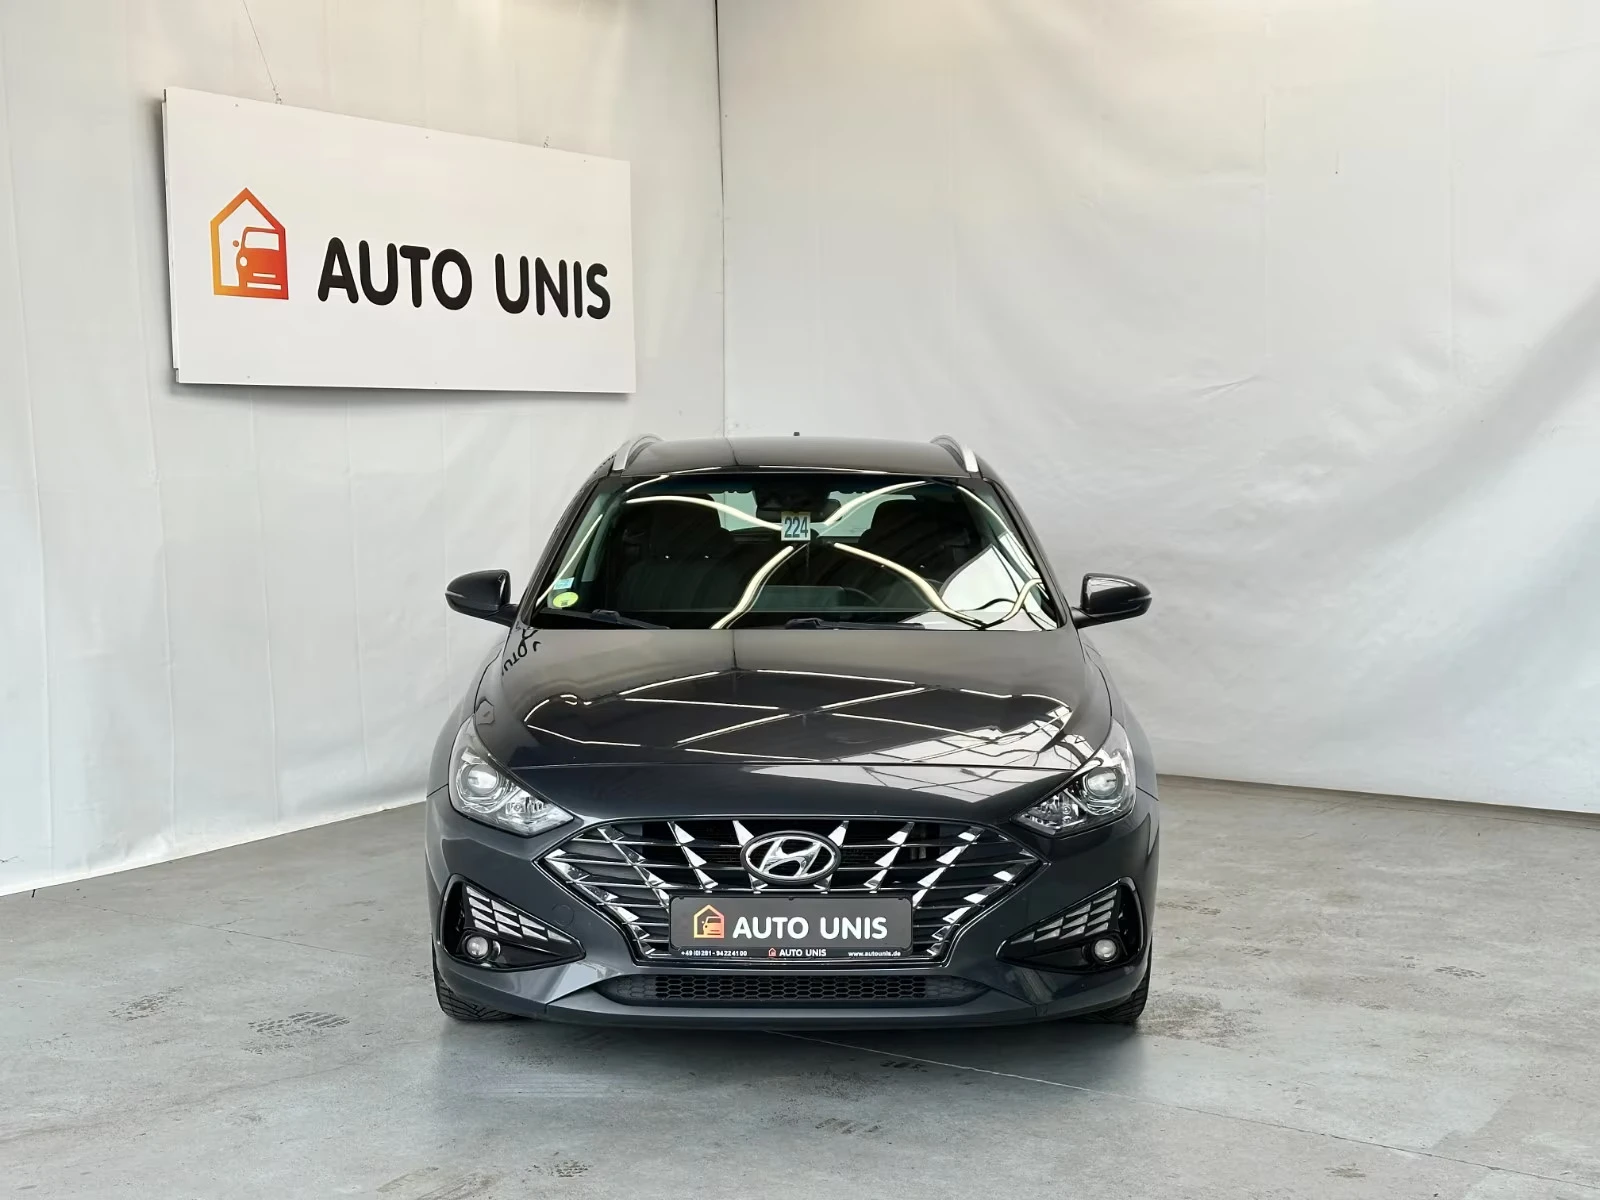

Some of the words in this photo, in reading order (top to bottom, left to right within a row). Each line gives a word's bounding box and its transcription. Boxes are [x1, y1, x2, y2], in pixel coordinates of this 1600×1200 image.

[318, 237, 472, 310] AUTO
[495, 254, 610, 319] UNIS
[784, 516, 808, 538] 224
[733, 917, 808, 940] AUTO
[820, 917, 887, 940] UNIS
[779, 949, 803, 957] AUTO
[805, 949, 826, 957] UNIS
